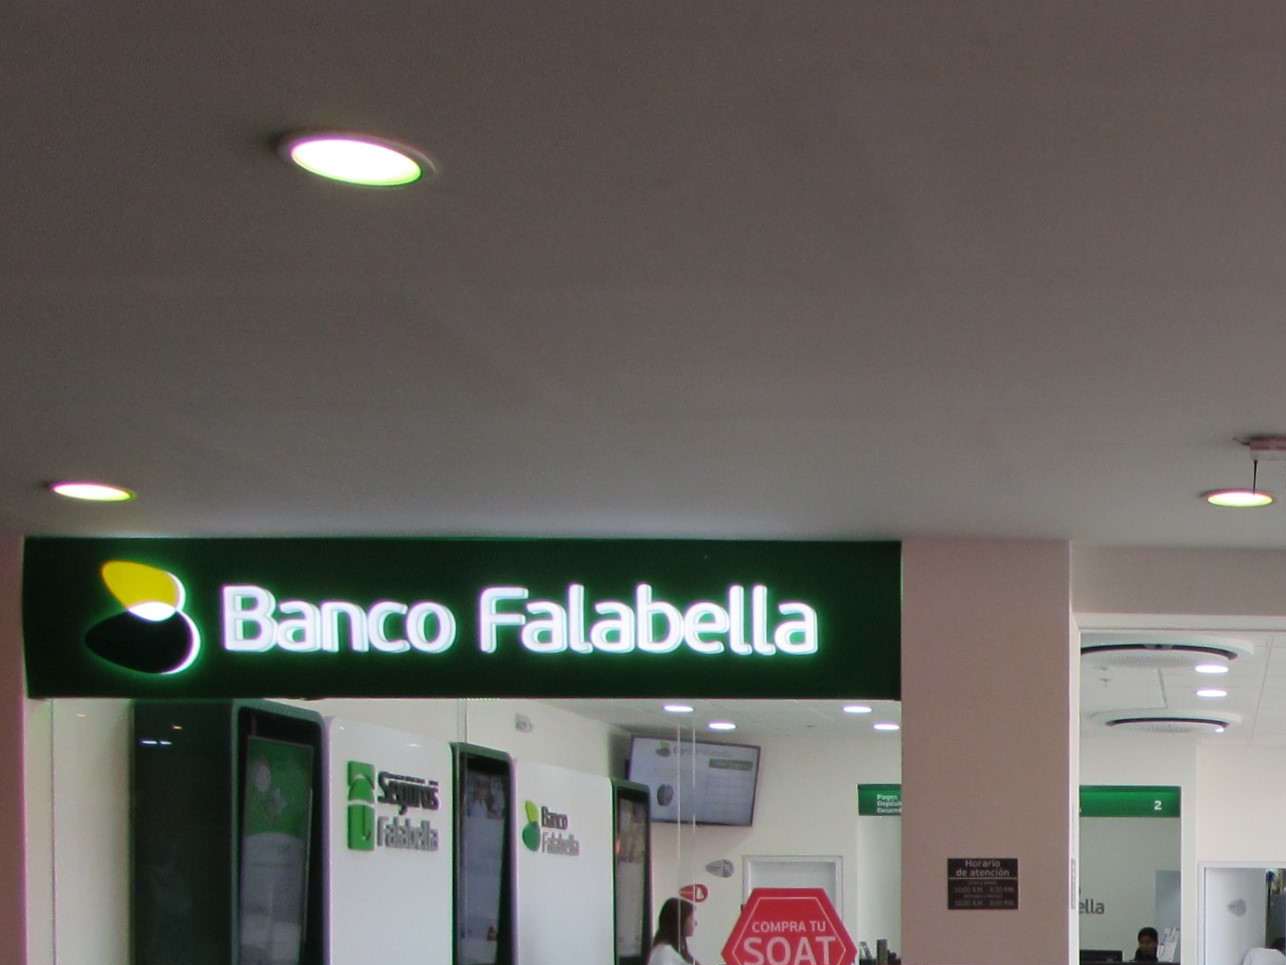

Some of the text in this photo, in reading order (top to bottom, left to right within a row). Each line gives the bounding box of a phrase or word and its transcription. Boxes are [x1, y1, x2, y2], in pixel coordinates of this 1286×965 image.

[223, 583, 819, 655] Banco Falabella
[378, 771, 440, 815] Seguros
[1154, 800, 1163, 811] 2
[541, 805, 569, 831] Banco
[377, 816, 440, 852] Falabella
[541, 831, 580, 857] Falabella
[956, 867, 1010, 877] de atención
[965, 859, 1001, 868] Horario
[752, 920, 826, 933] COMPRA TU
